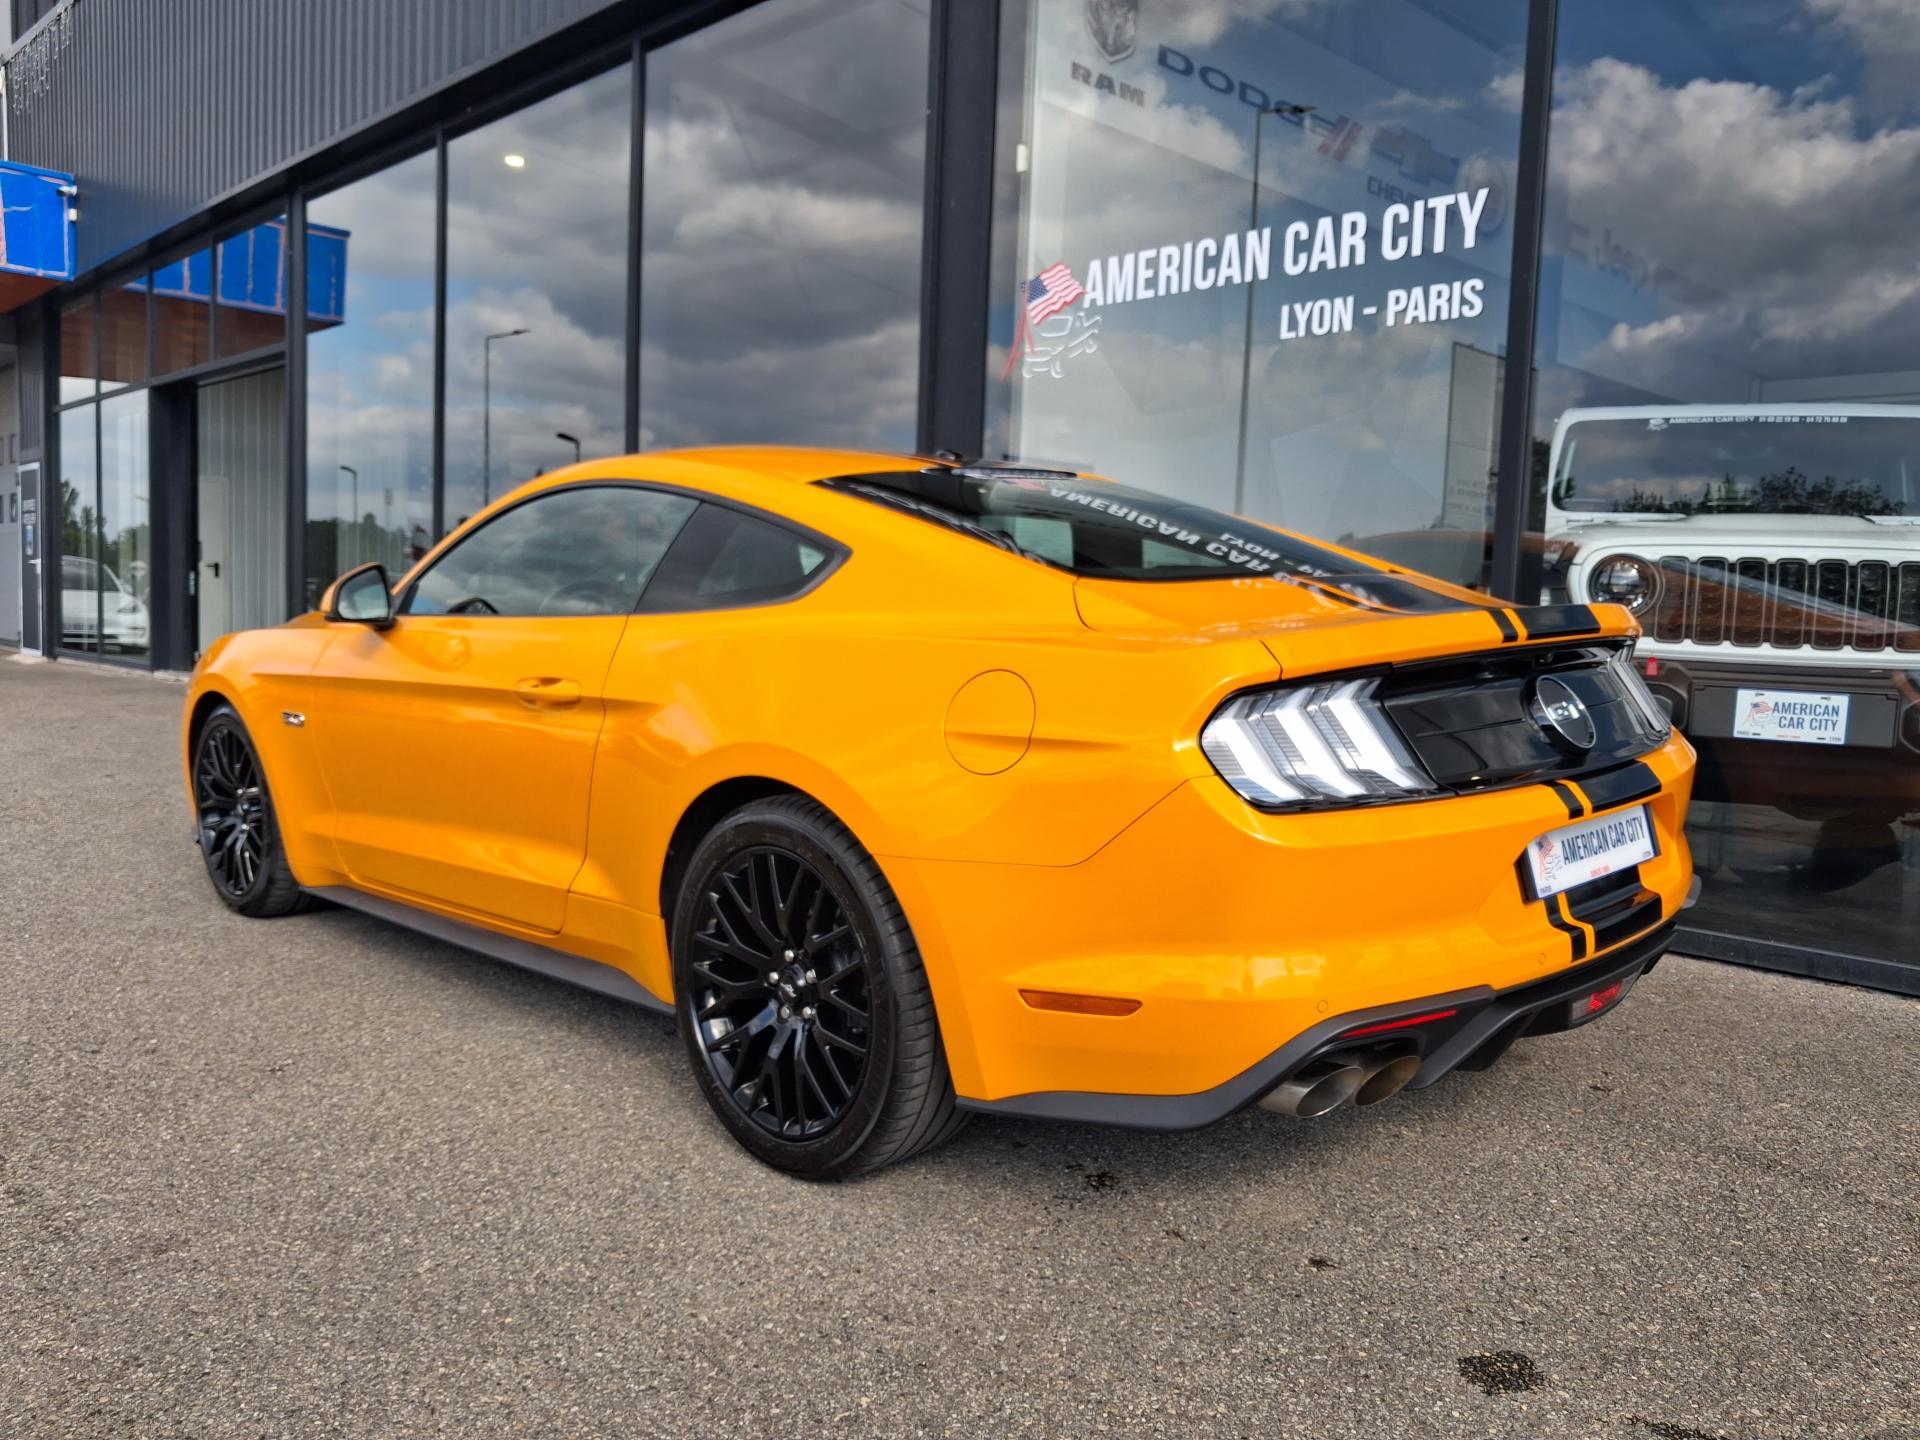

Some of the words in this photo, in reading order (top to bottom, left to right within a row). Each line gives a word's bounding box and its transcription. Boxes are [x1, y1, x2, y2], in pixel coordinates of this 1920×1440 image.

[1071, 61, 1146, 107] RAM
[1082, 226, 1271, 309] AMERICAN
[1283, 211, 1368, 276] CAR
[1381, 187, 1489, 261] CITY
[1280, 295, 1354, 340] LYON
[1386, 278, 1485, 327] PARIS
[1669, 416, 1714, 424] AMERICAN
[1772, 701, 1840, 717] AMERICAN
[1779, 716, 1805, 730] CAR
[1809, 717, 1839, 732] CITY
[1561, 826, 1607, 865] AMERICAN
[1608, 821, 1626, 849] CAR
[1625, 815, 1645, 843] CITY
